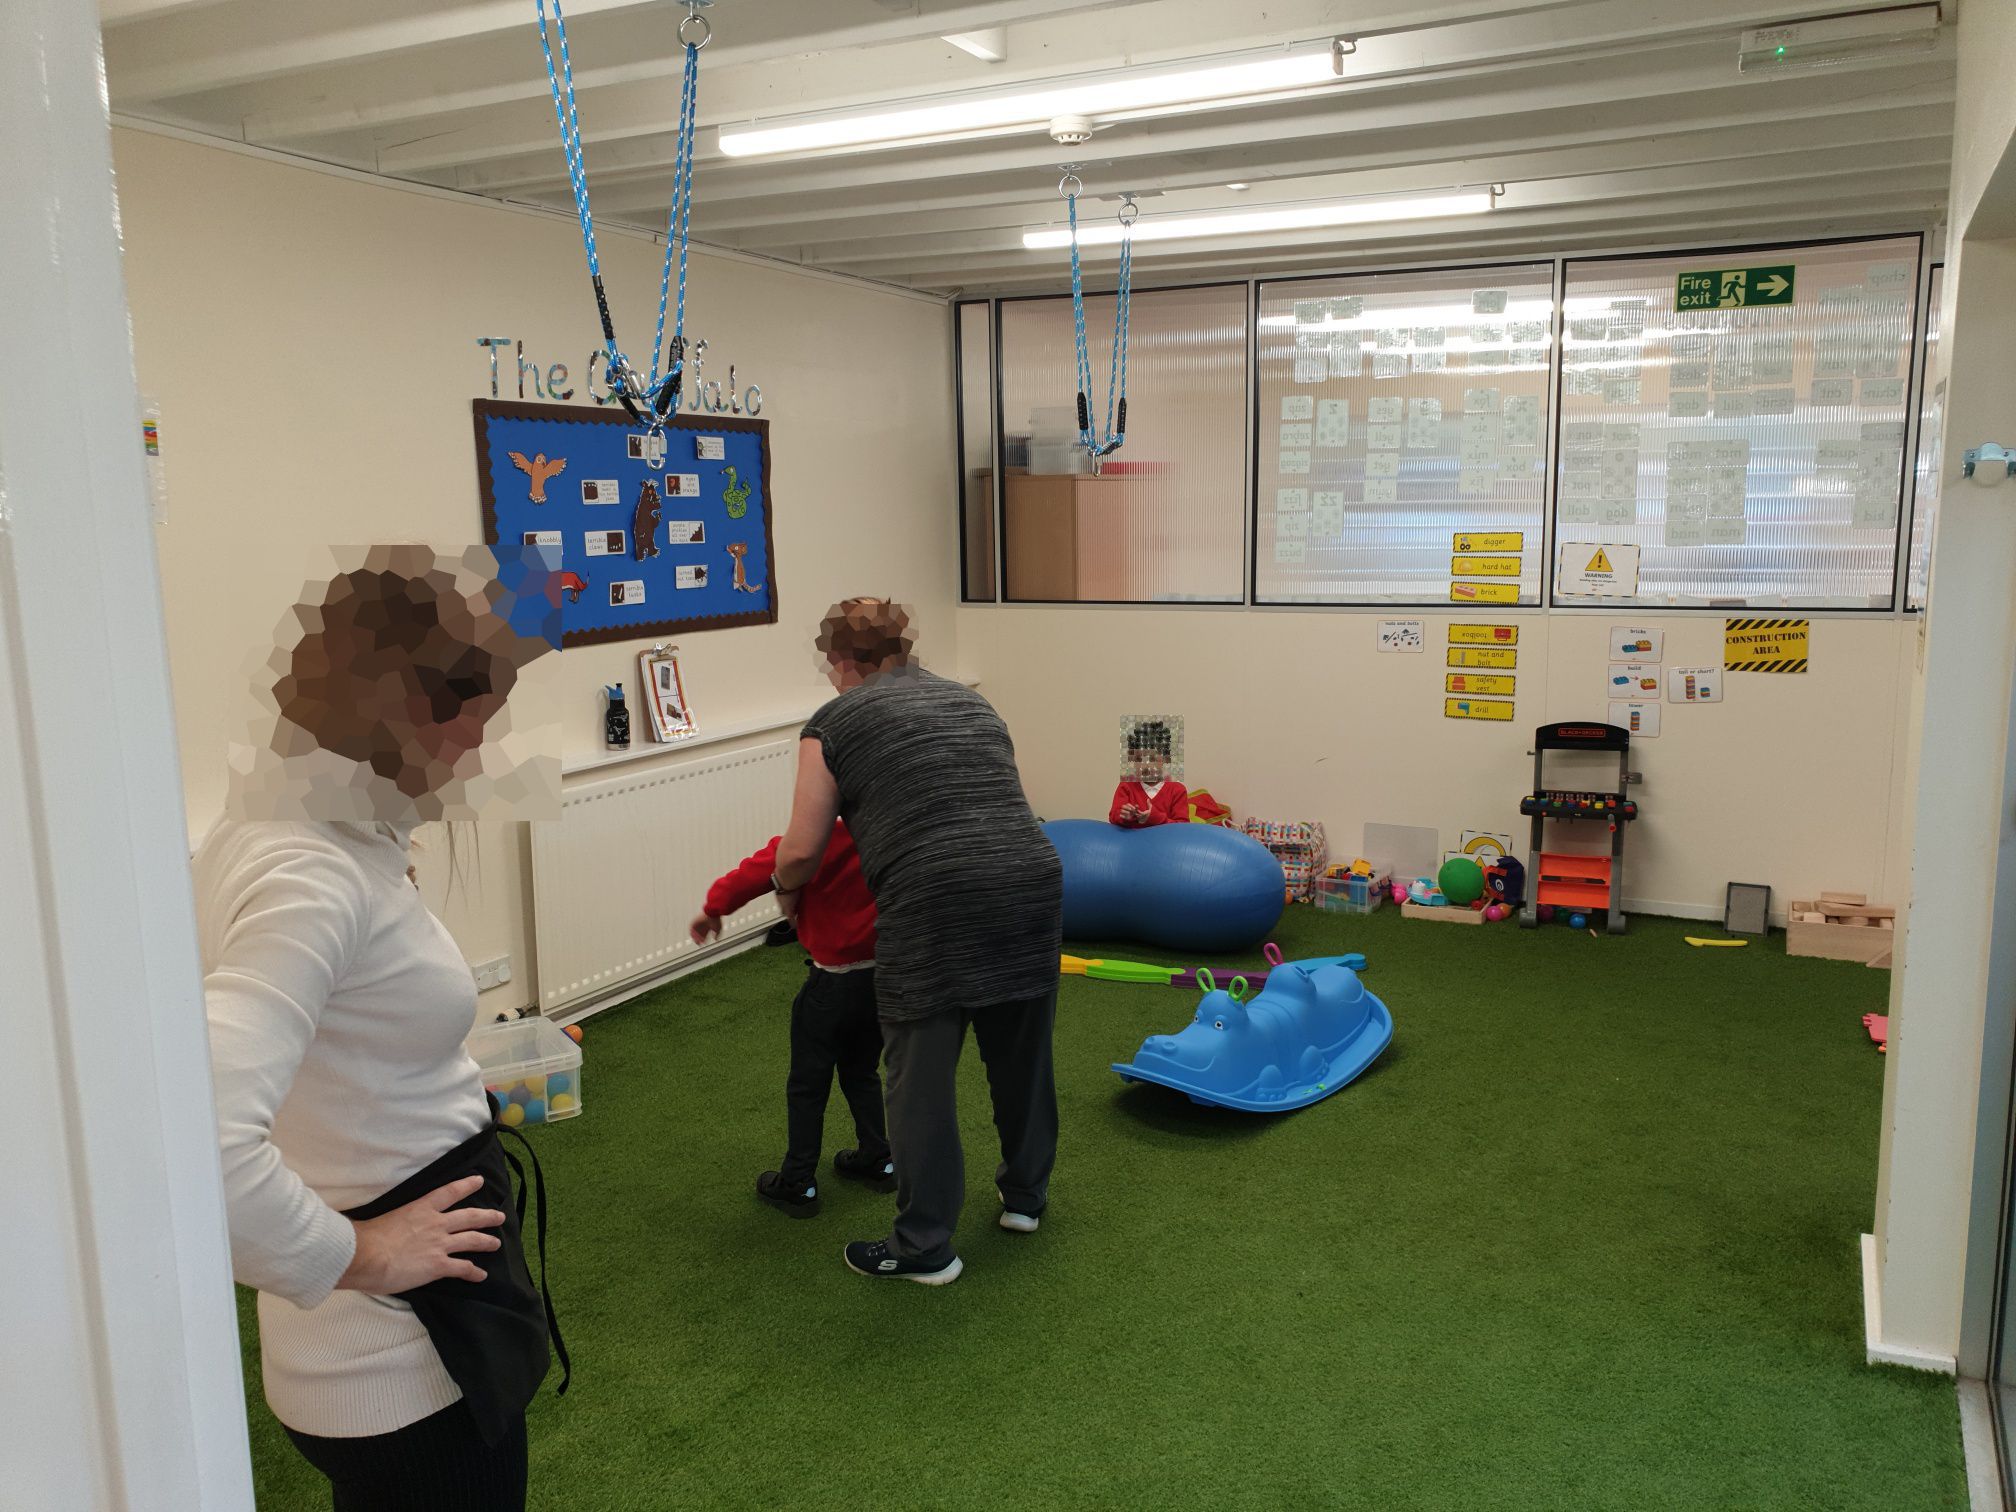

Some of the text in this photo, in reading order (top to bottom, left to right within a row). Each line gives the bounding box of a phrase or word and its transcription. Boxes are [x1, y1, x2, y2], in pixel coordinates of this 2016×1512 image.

[1680, 276, 1711, 290] Fire
[1680, 291, 1711, 305] exit
[477, 337, 574, 400] The
[1484, 537, 1505, 547] digger
[1480, 588, 1497, 596] brick
[1462, 631, 1487, 639] toolbox
[1726, 631, 1806, 644] CONSTRUCTION
[1753, 645, 1781, 655] AREA
[1476, 675, 1497, 685] safety
[1475, 705, 1489, 713] drill
